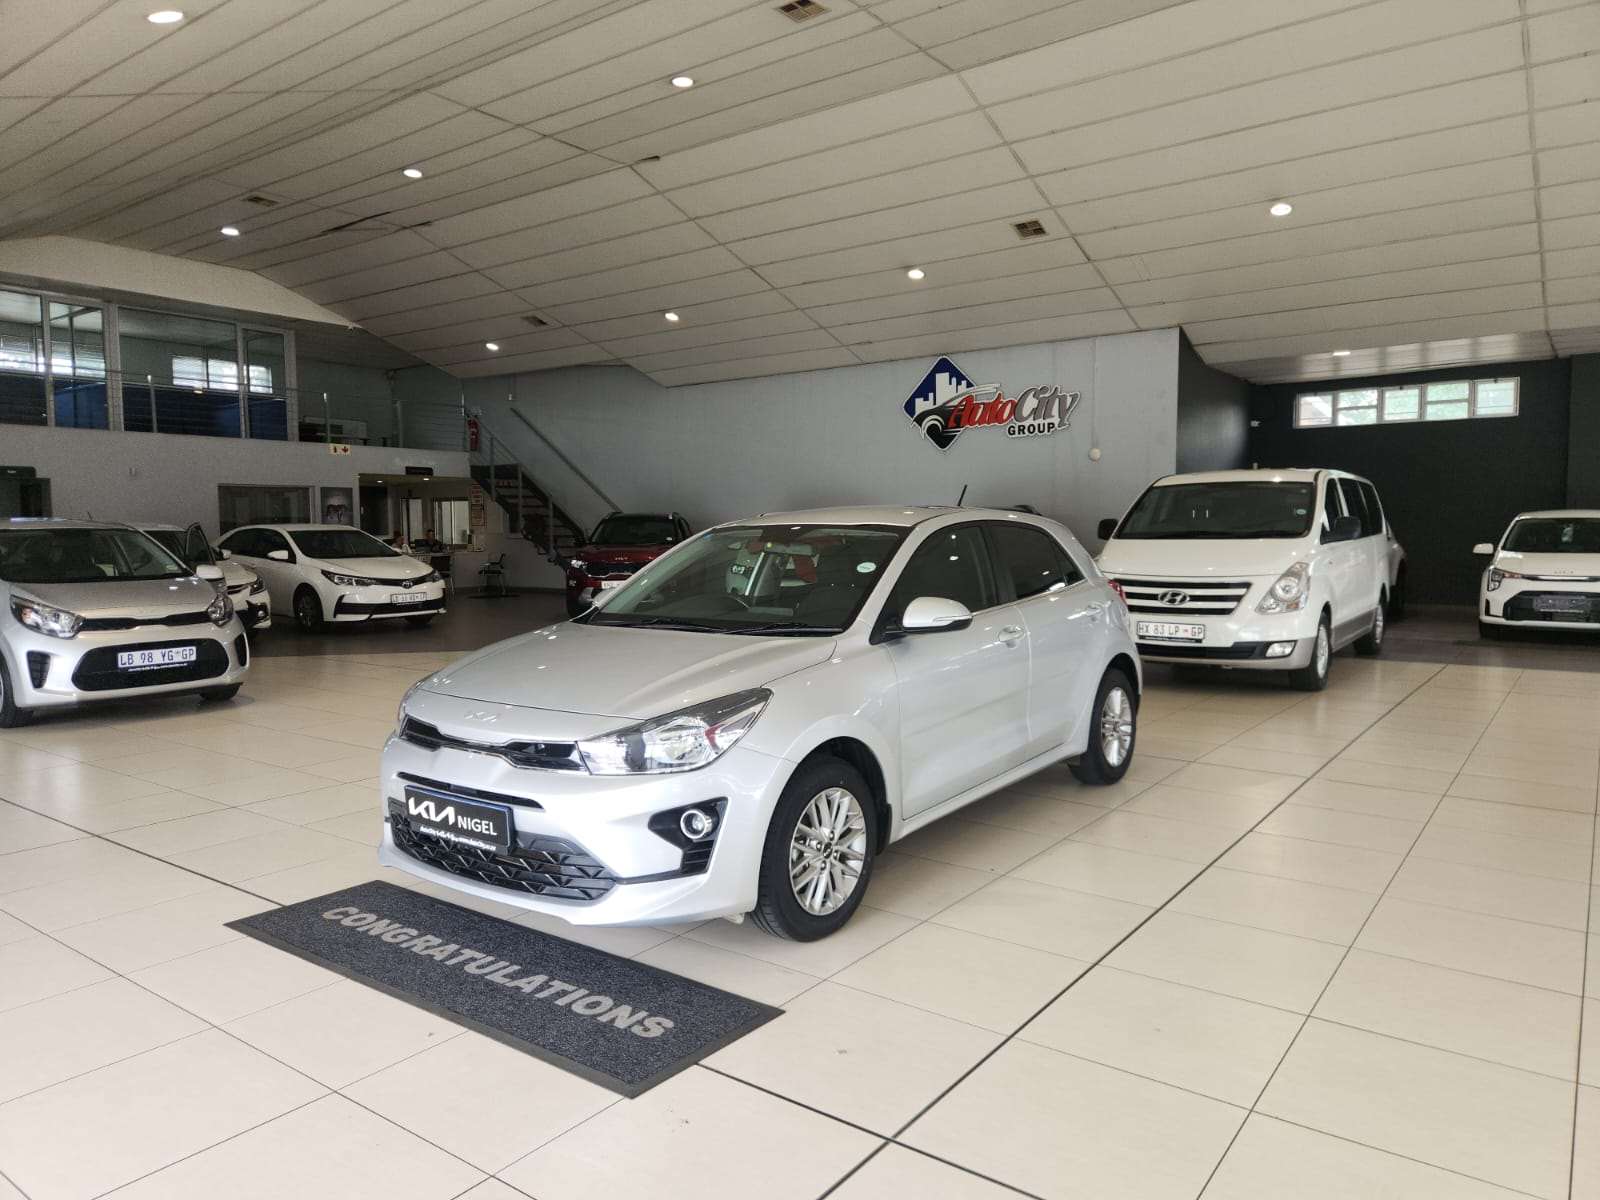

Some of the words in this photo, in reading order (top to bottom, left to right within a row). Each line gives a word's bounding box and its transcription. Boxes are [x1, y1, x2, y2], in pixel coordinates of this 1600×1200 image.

[1007, 421, 1056, 436] GROUP
[1191, 626, 1203, 637] GP
[120, 653, 134, 666] LB
[140, 652, 154, 664] 98
[160, 649, 174, 662] YG
[181, 648, 195, 660] GP
[408, 797, 456, 826] KIA
[457, 815, 498, 836] NIGEL
[322, 906, 675, 1039] CONGRATULATIONS
